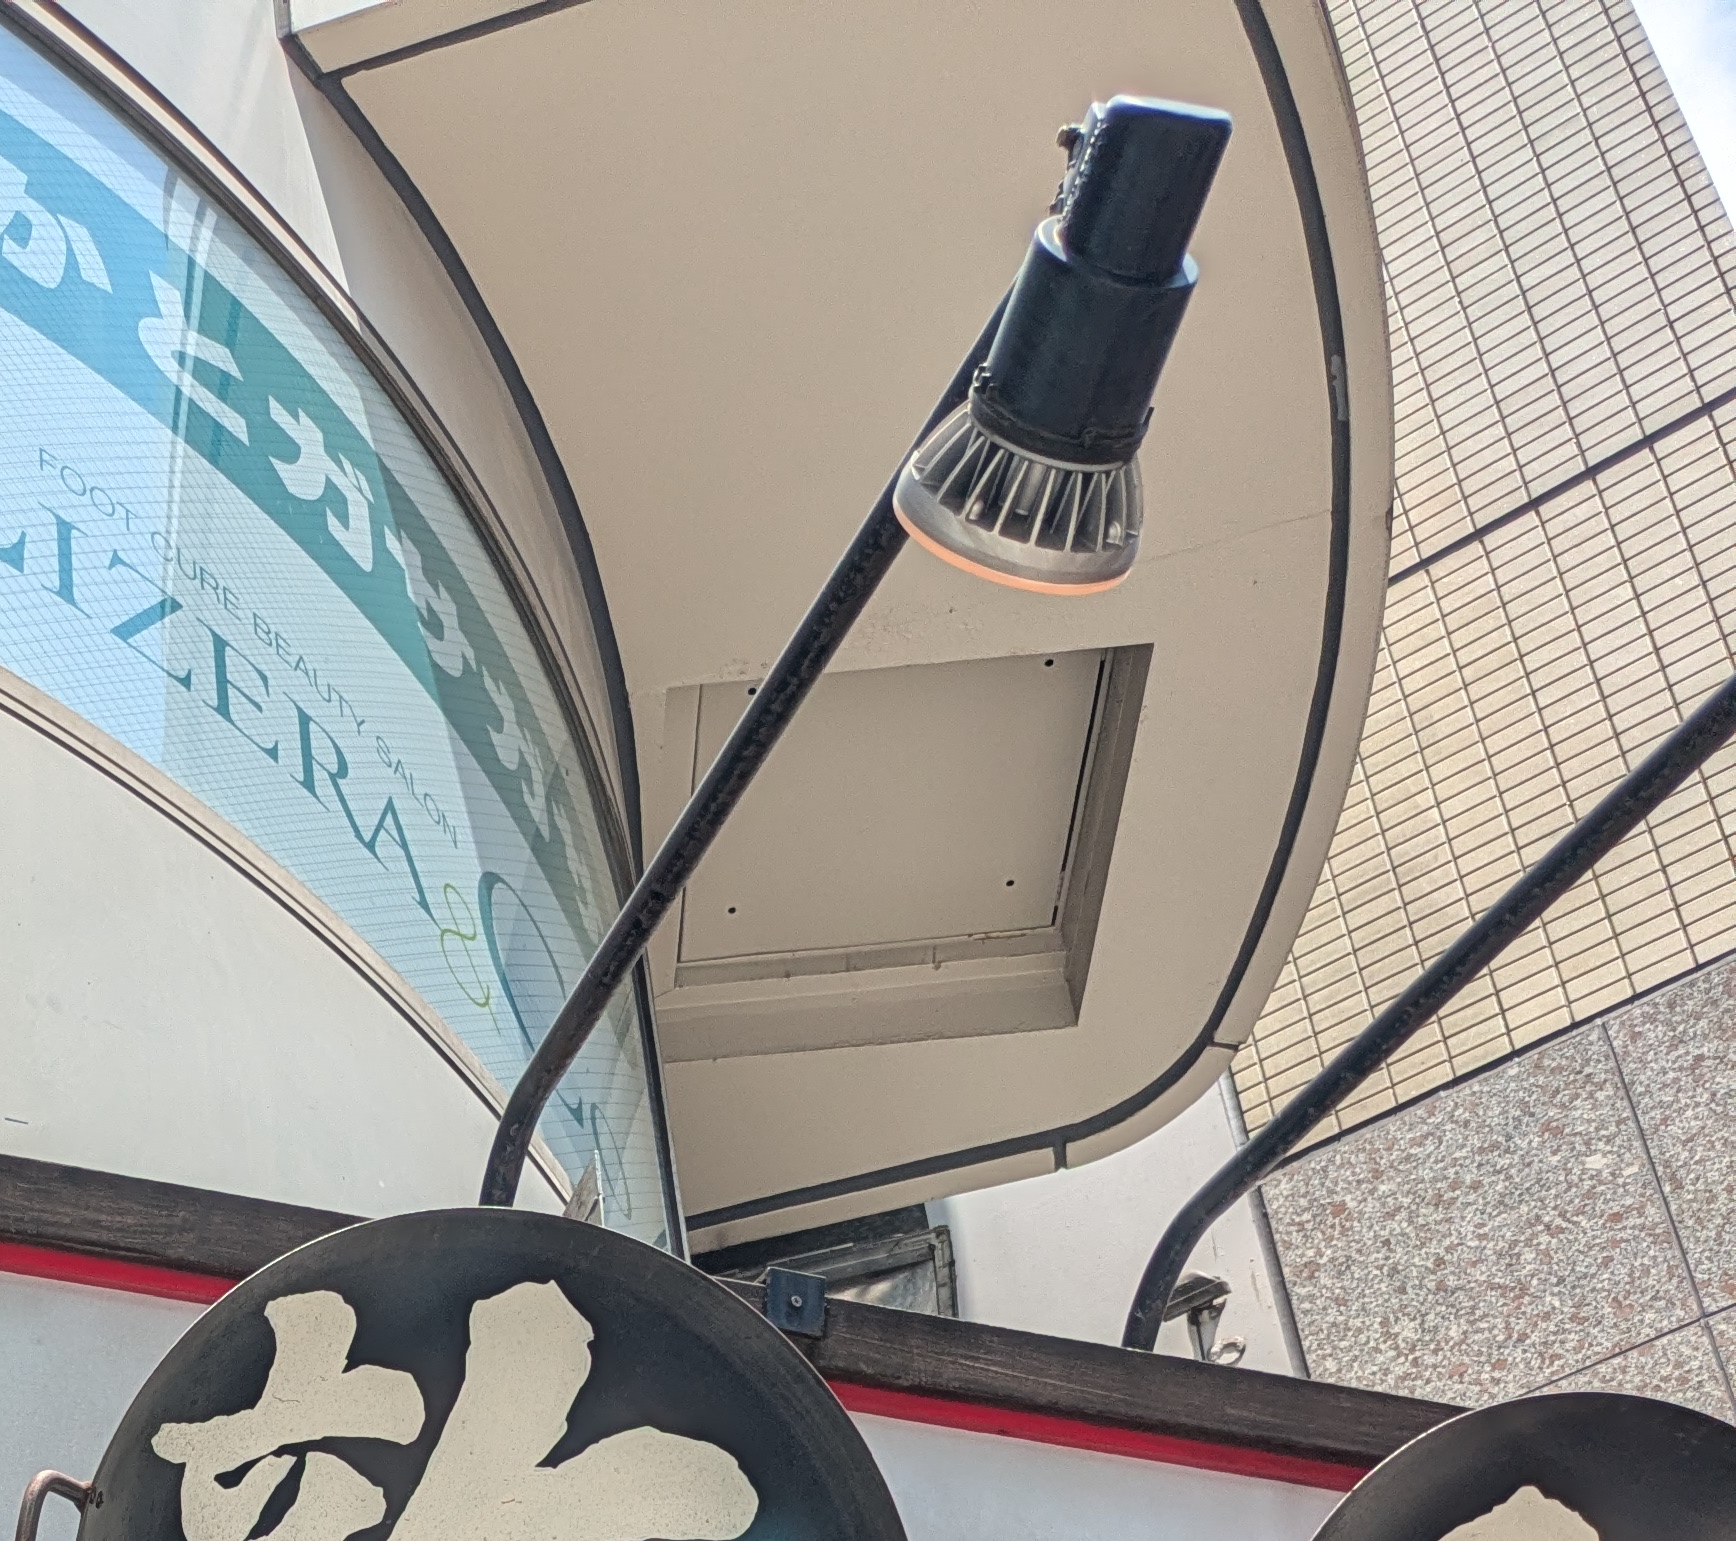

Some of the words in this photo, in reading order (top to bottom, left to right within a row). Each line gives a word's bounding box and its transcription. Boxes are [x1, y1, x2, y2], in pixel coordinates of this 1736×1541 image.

[38, 446, 137, 534] FOOT
[150, 530, 242, 613] CURE
[253, 612, 368, 739] BEAUTY
[375, 735, 458, 850] SALON
